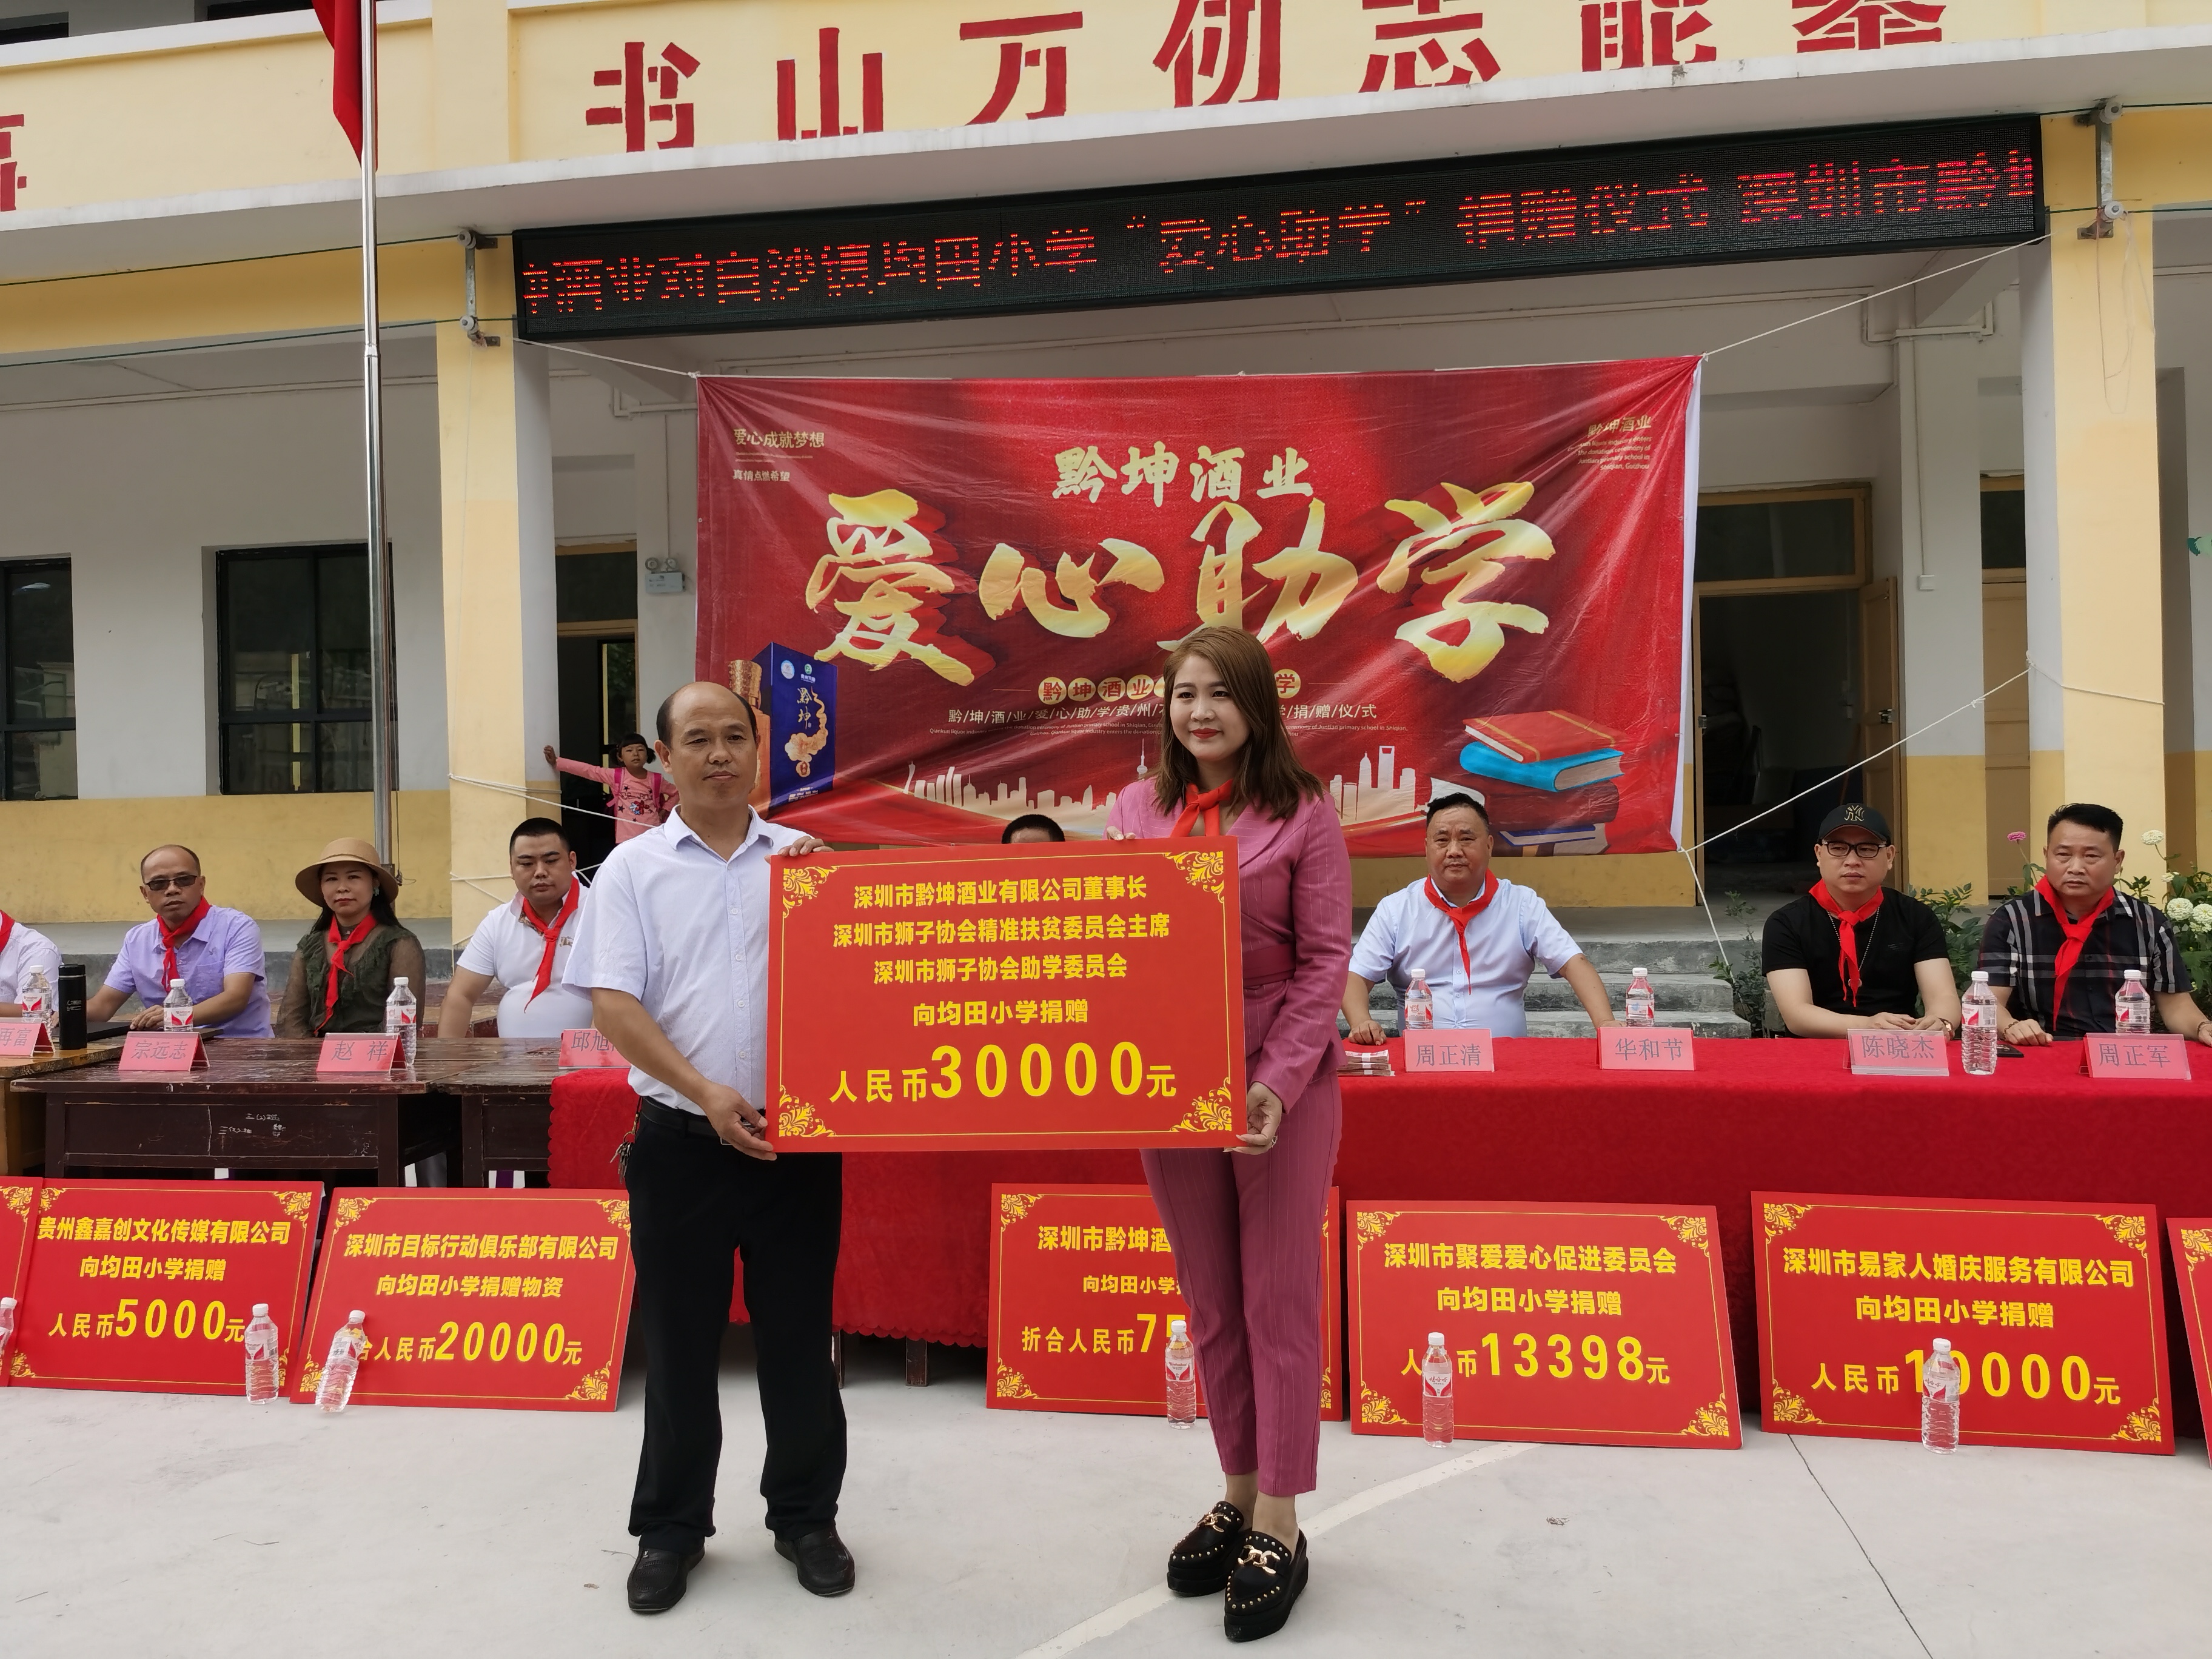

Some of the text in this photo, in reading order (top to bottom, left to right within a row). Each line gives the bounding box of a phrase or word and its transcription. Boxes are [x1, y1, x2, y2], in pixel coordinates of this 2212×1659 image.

[734, 428, 825, 448] 爱心成就梦想
[1587, 415, 1652, 438] 黔坤酒业
[732, 469, 790, 482] 真情点燃希望
[1052, 441, 1313, 507] 黔坤酒业
[805, 481, 1555, 684] 爱心助学
[1043, 673, 1295, 702] 黔坤酒业 学
[853, 874, 1147, 909] 深圳市黔坤酒业有限公司董事长
[833, 912, 1170, 948] 深圳市狮子协会精准扶贫委员会主席
[873, 953, 1128, 985] 深圳市狮子协会助学委员会
[913, 998, 1089, 1027] 向均田小学捐赠
[130, 1039, 188, 1060] 宗远志
[571, 1030, 614, 1052] 邱旭
[1416, 1043, 1481, 1067] 周正清
[1614, 1037, 1684, 1062] 华和节
[1861, 1034, 1934, 1060] 陈晓杰
[2098, 1042, 2171, 1068] 周正军
[37, 1215, 291, 1245] 贵州鑫嘉创文化传媒有限公司
[1037, 1225, 1172, 1253] 深圳市黔坤酒
[344, 1233, 618, 1260] 深圳市目标行动俱乐部有限公司
[1384, 1242, 1677, 1273] 深圳市聚爱爱心促进委员会
[79, 1255, 227, 1281] 向均田小学捐赠
[1783, 1246, 2134, 1287] 深圳市易家人婚庆服务有限公司
[376, 1273, 564, 1298] 向均田小学捐赠物资
[1083, 1274, 1182, 1295] 向均田小学
[1437, 1285, 1622, 1316] 向均田小学捐赠
[1855, 1295, 2054, 1329] 向均田小学捐赠
[1401, 1332, 1671, 1385] 人币13398元
